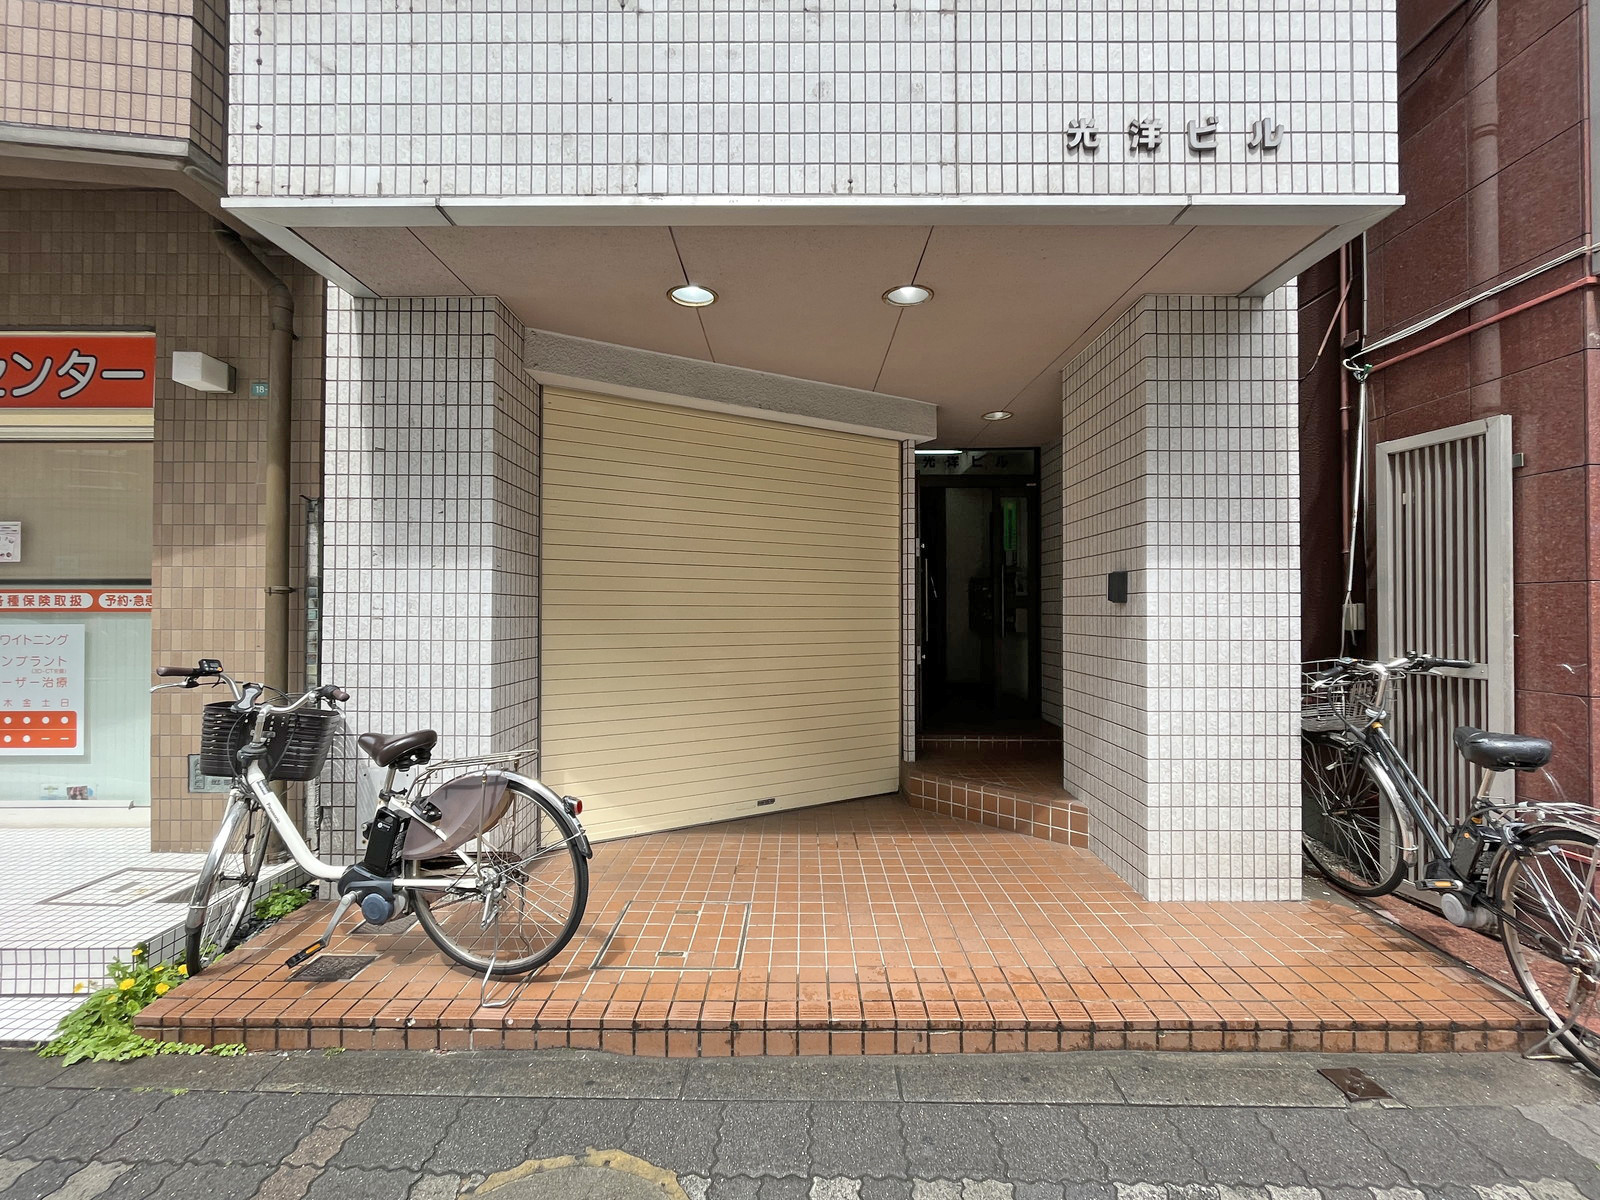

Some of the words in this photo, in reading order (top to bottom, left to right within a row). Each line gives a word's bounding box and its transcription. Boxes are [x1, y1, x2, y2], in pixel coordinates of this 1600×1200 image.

[1066, 117, 1285, 151] 光洋ビル
[0, 349, 145, 399] ンター
[0, 595, 82, 607] 種保険取扱
[60, 698, 69, 707] 日
